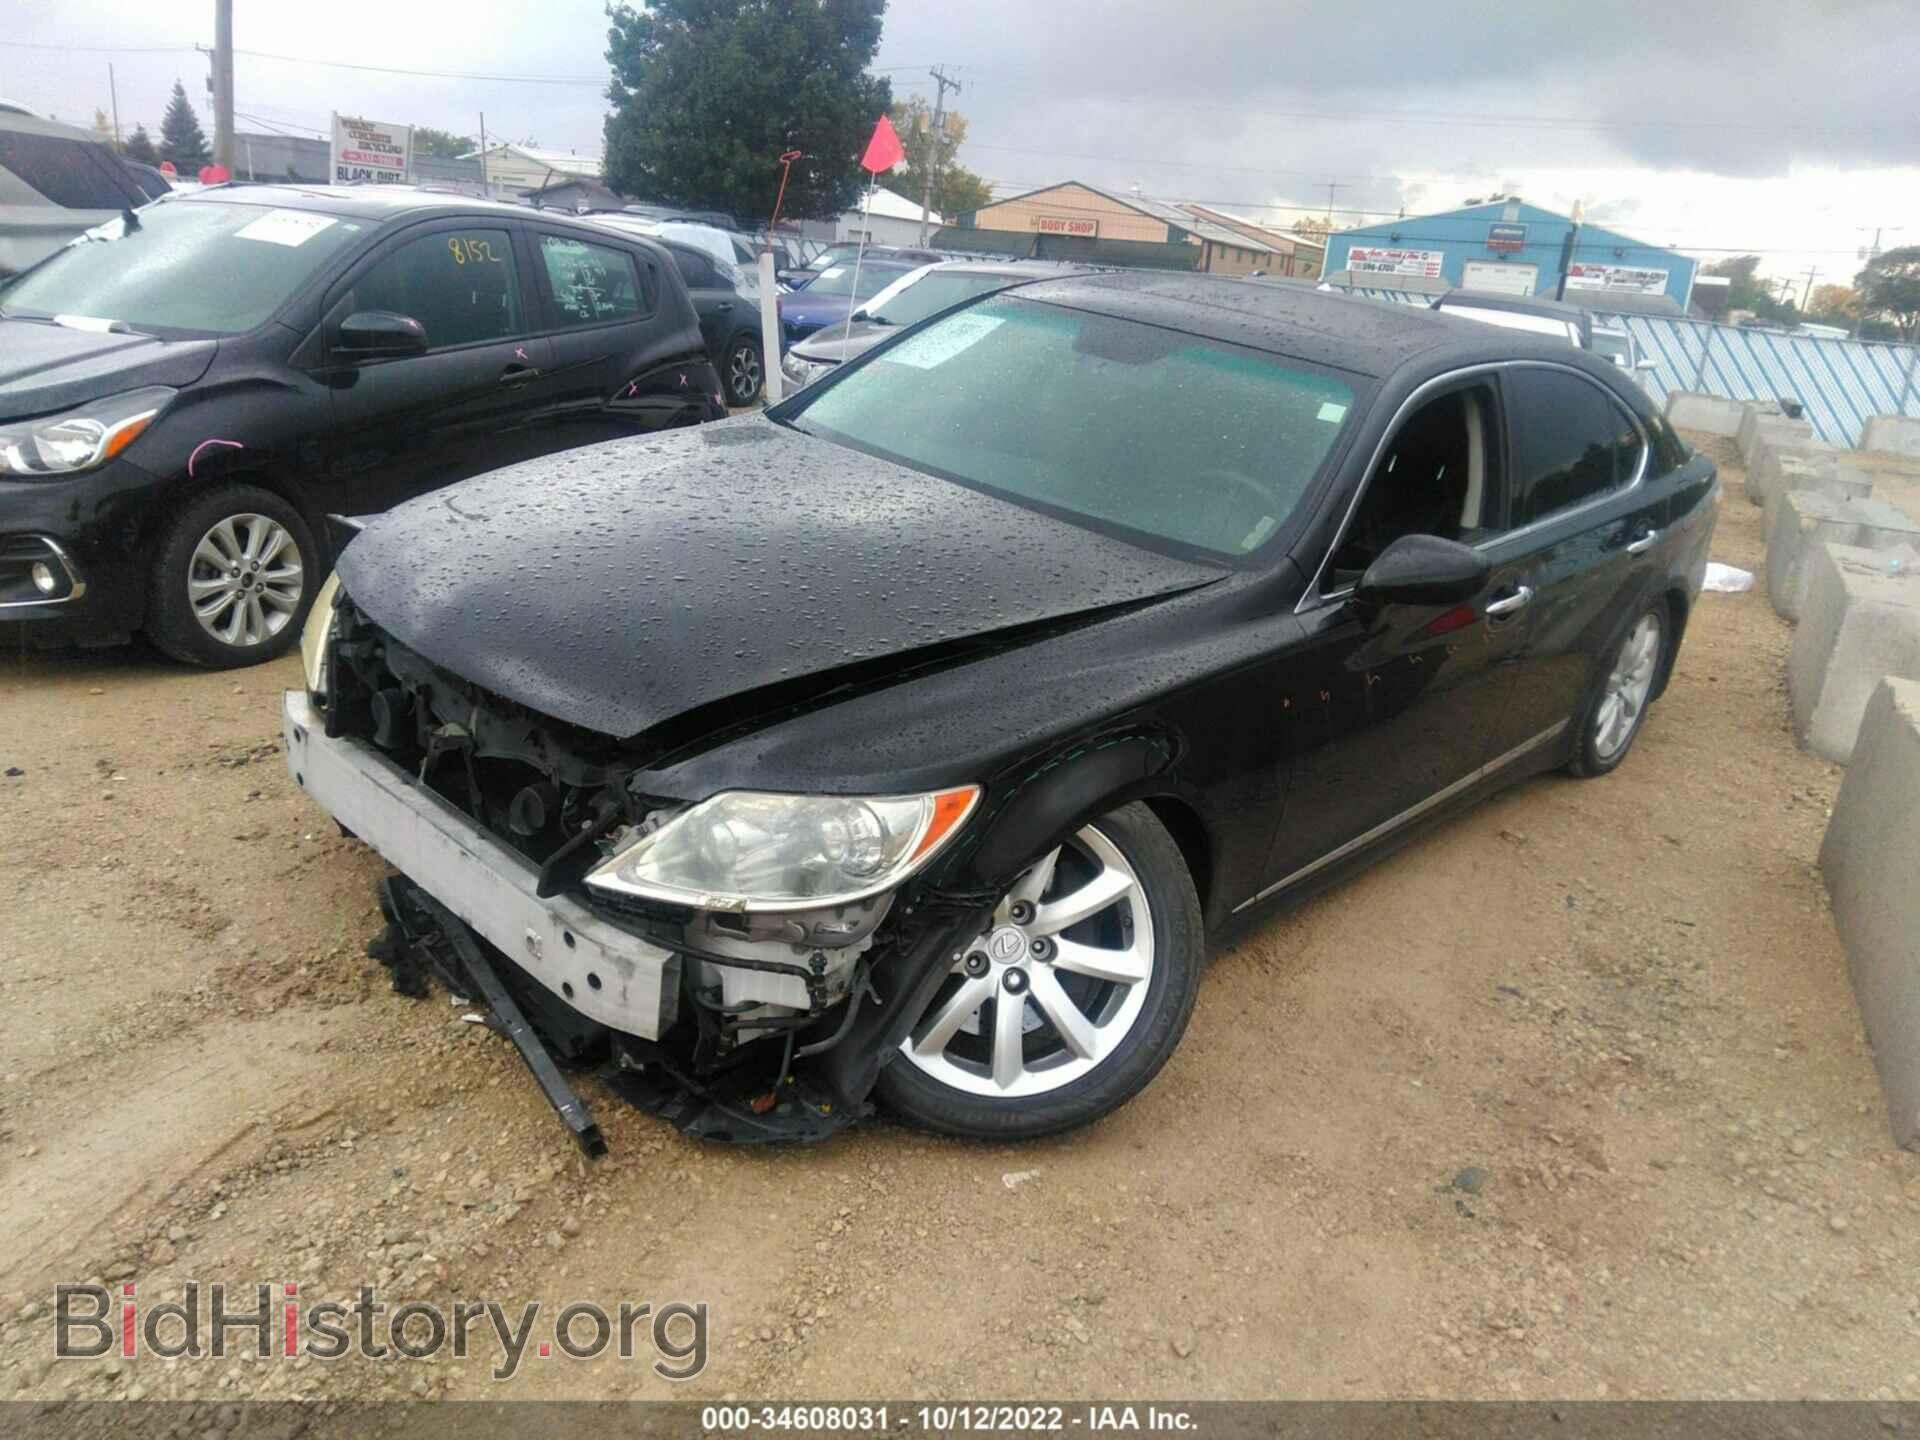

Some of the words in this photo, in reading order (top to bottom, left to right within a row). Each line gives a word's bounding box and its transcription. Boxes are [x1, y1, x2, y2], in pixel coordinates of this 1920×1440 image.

[337, 166, 373, 182] BLACK
[1040, 219, 1066, 232] BODY
[1068, 221, 1094, 233] SHOP
[448, 238, 501, 264] 8152
